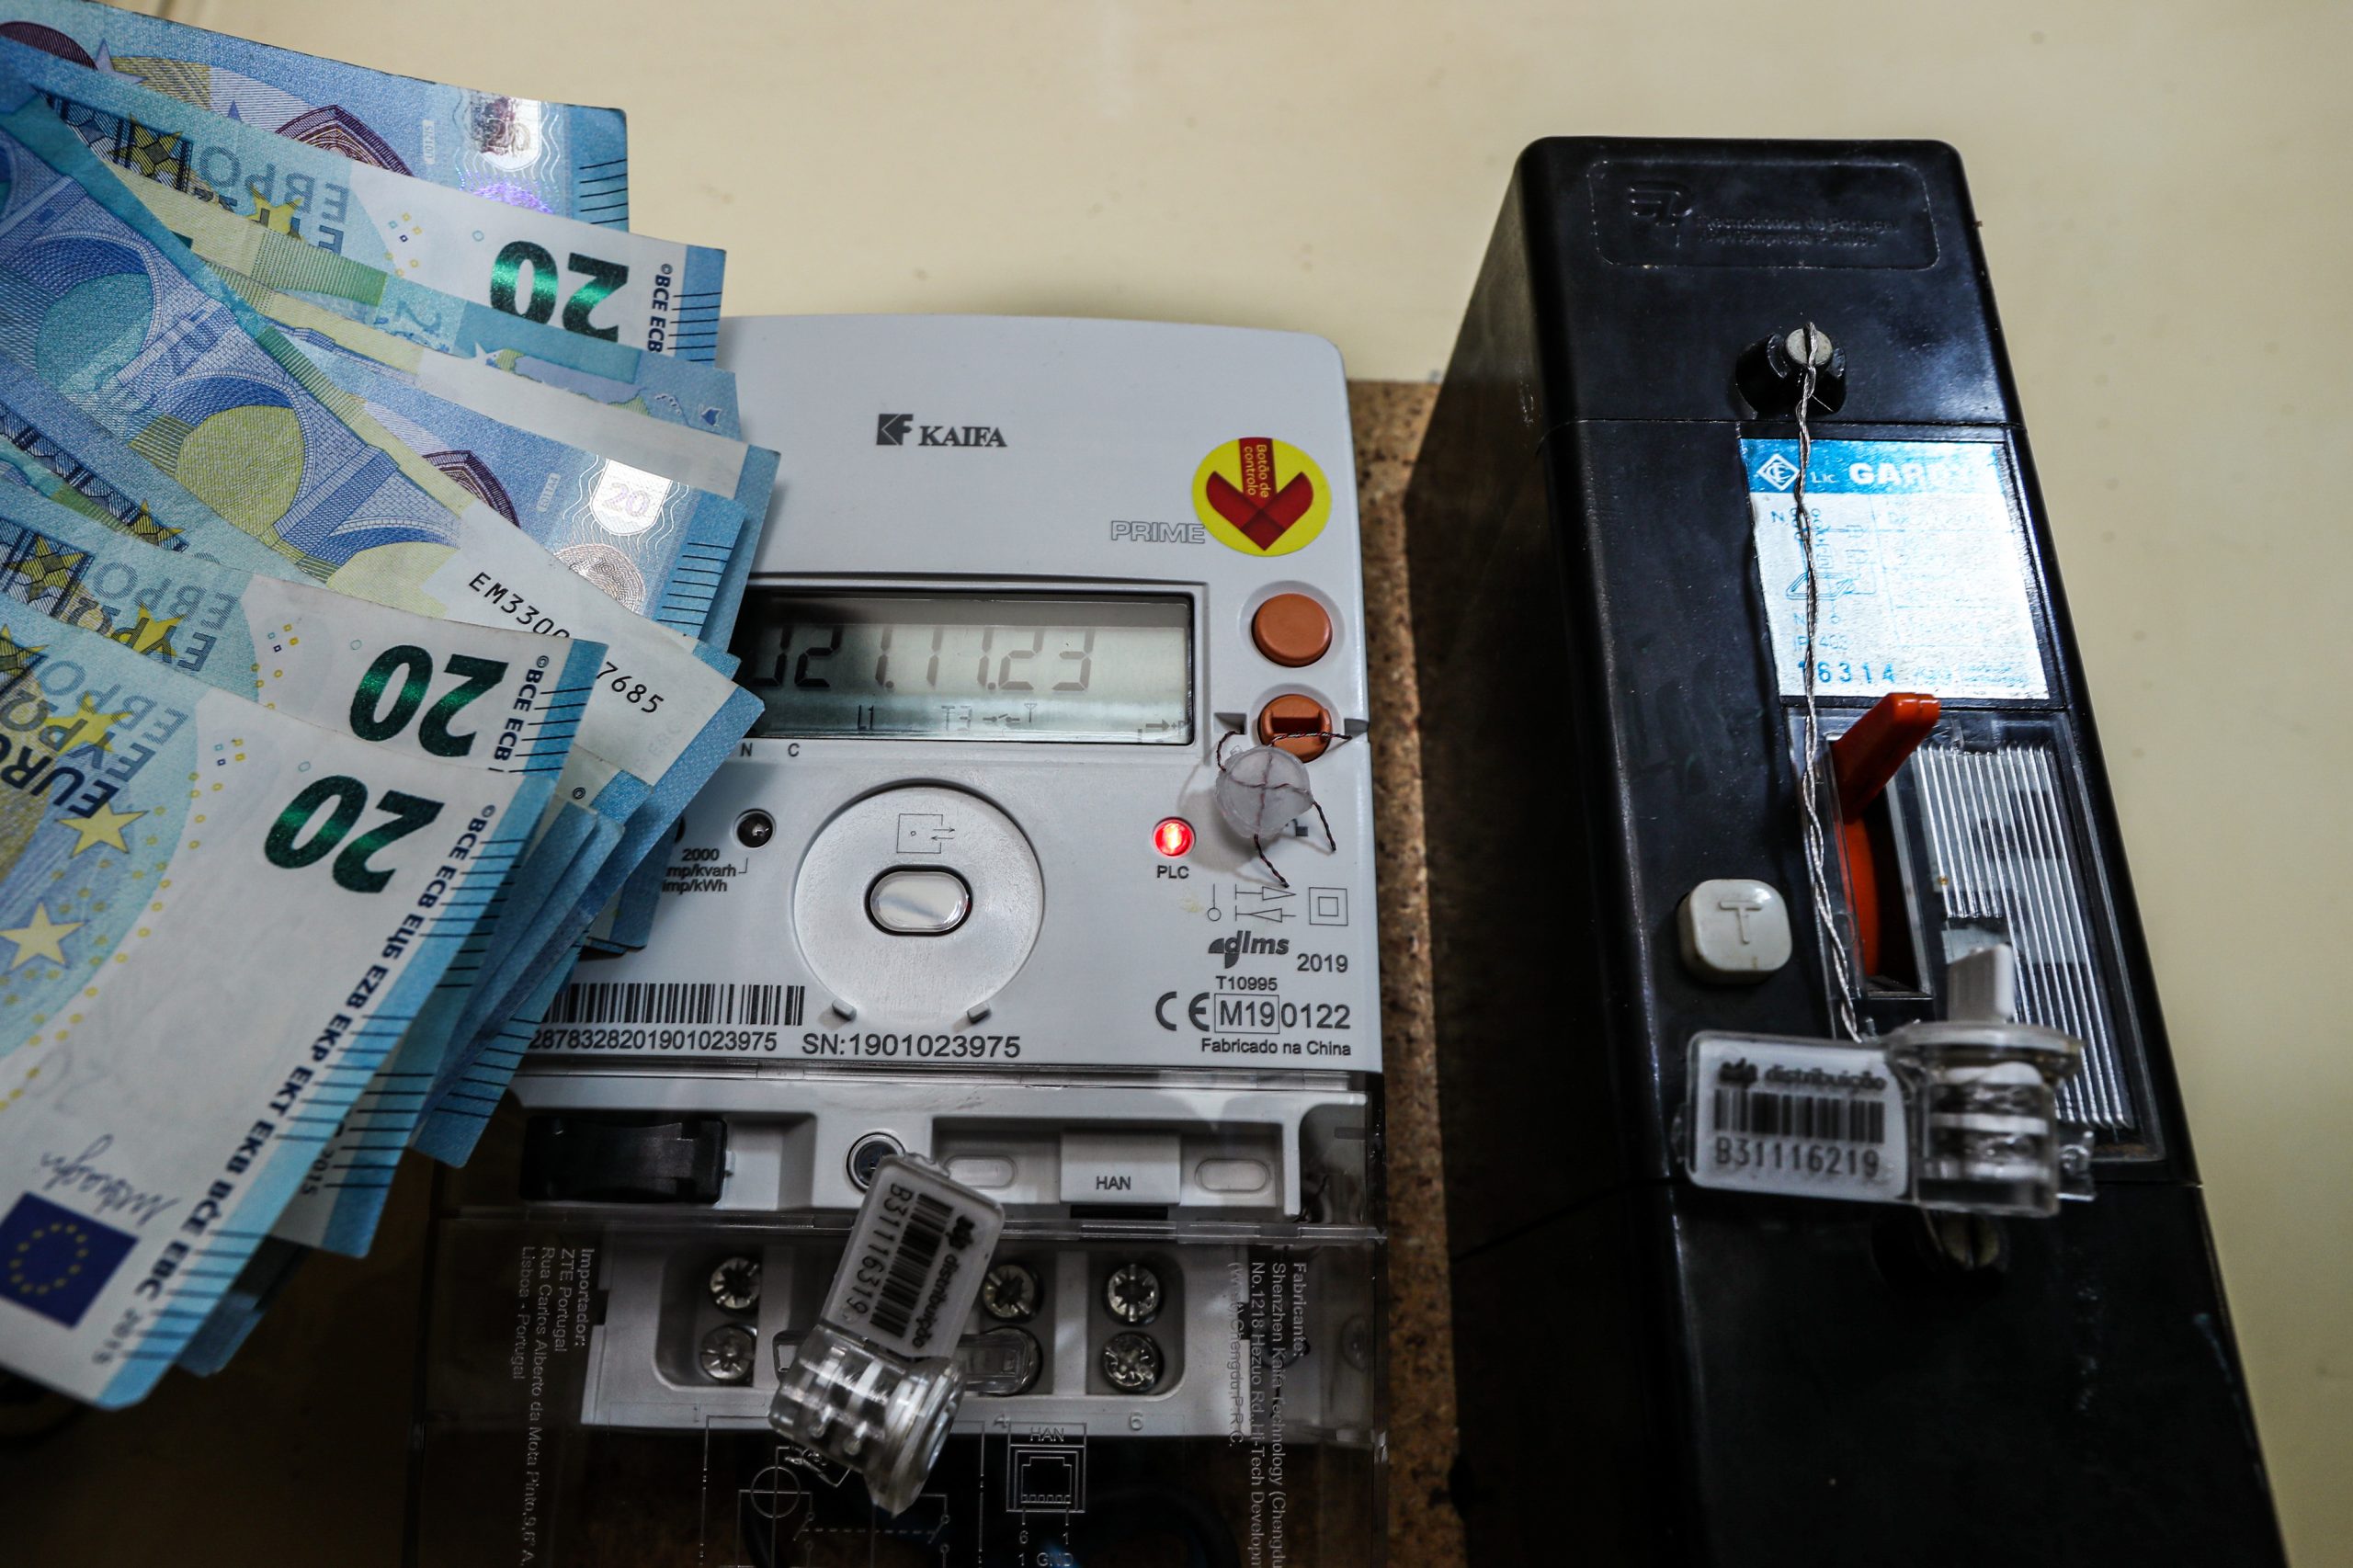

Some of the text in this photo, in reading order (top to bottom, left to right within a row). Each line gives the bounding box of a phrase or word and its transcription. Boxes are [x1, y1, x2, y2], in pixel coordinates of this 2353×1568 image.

[490, 240, 630, 344] 20
[647, 315, 666, 354] ECB
[918, 426, 1008, 448] KAIFA
[1244, 446, 1258, 496] controlo
[1256, 444, 1271, 498] Botão de
[1110, 520, 1206, 544] PRIME
[349, 644, 509, 757] 20
[596, 661, 665, 713] 7685
[494, 718, 524, 761] ECB
[740, 743, 800, 757] N C
[265, 775, 445, 893] 20
[681, 847, 720, 861] 2000
[417, 865, 458, 908] ECB
[1156, 865, 1189, 880] PLC
[1720, 901, 1763, 944] T
[1215, 975, 1278, 991] T10995
[1297, 953, 1348, 973] 2019
[346, 964, 389, 1009] EZB
[1220, 1000, 1276, 1027] M19
[1280, 1002, 1351, 1029] 0122
[311, 1014, 353, 1062] EKP
[802, 1033, 1021, 1058] SN:1901023975
[1201, 1038, 1351, 1056] Fabricado na China
[227, 1119, 275, 1175] EKB
[1715, 1136, 1881, 1178] B31116219
[1096, 1176, 1131, 1190] HAN
[134, 1240, 190, 1301] EBC
[540, 1247, 556, 1278] Rua
[846, 1183, 915, 1315] B31116319
[518, 1246, 536, 1299] Lisboa
[536, 1283, 553, 1335] Carlos
[553, 1247, 576, 1352] ZTE Portugal
[574, 1248, 596, 1347] Importador:
[1271, 1262, 1287, 1343] Shenzhen
[1292, 1262, 1307, 1358] Fabricante:
[510, 1313, 530, 1380] Portugal
[530, 1338, 549, 1397] Alberto
[1251, 1334, 1267, 1386] Hezuo
[1271, 1347, 1287, 1389] Kaifa
[529, 1400, 545, 1422] da
[1129, 1412, 1144, 1431] 6
[527, 1426, 543, 1466] Mota
[1030, 1426, 1065, 1442] HAN
[1018, 1529, 1069, 1545] 6 1
[1018, 1552, 1025, 1566] 1
